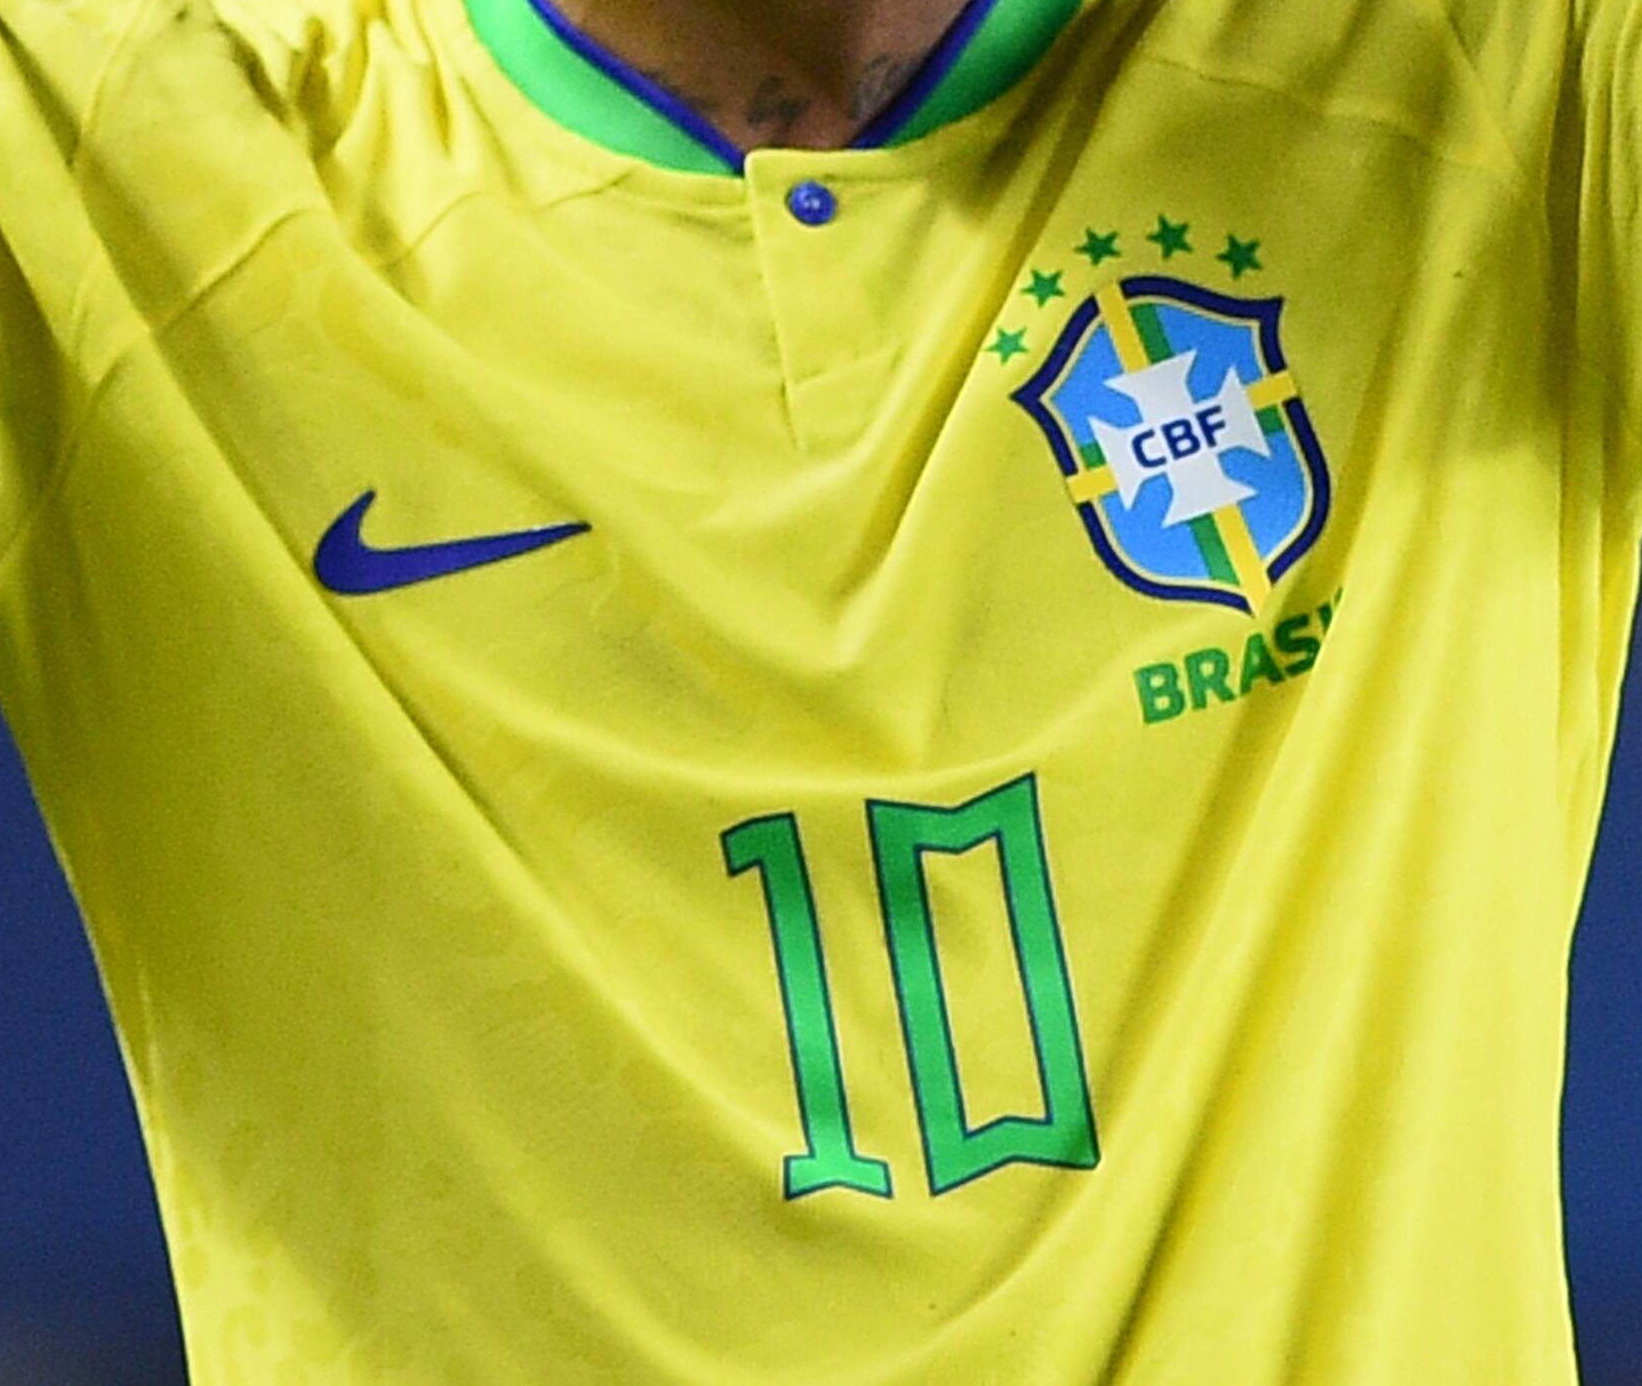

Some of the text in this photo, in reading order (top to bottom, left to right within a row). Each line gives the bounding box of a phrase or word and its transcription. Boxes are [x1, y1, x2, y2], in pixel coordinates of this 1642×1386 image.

[1131, 404, 1227, 469] CBF
[1134, 585, 1345, 725] BRAS
[719, 770, 1101, 1202] 10
